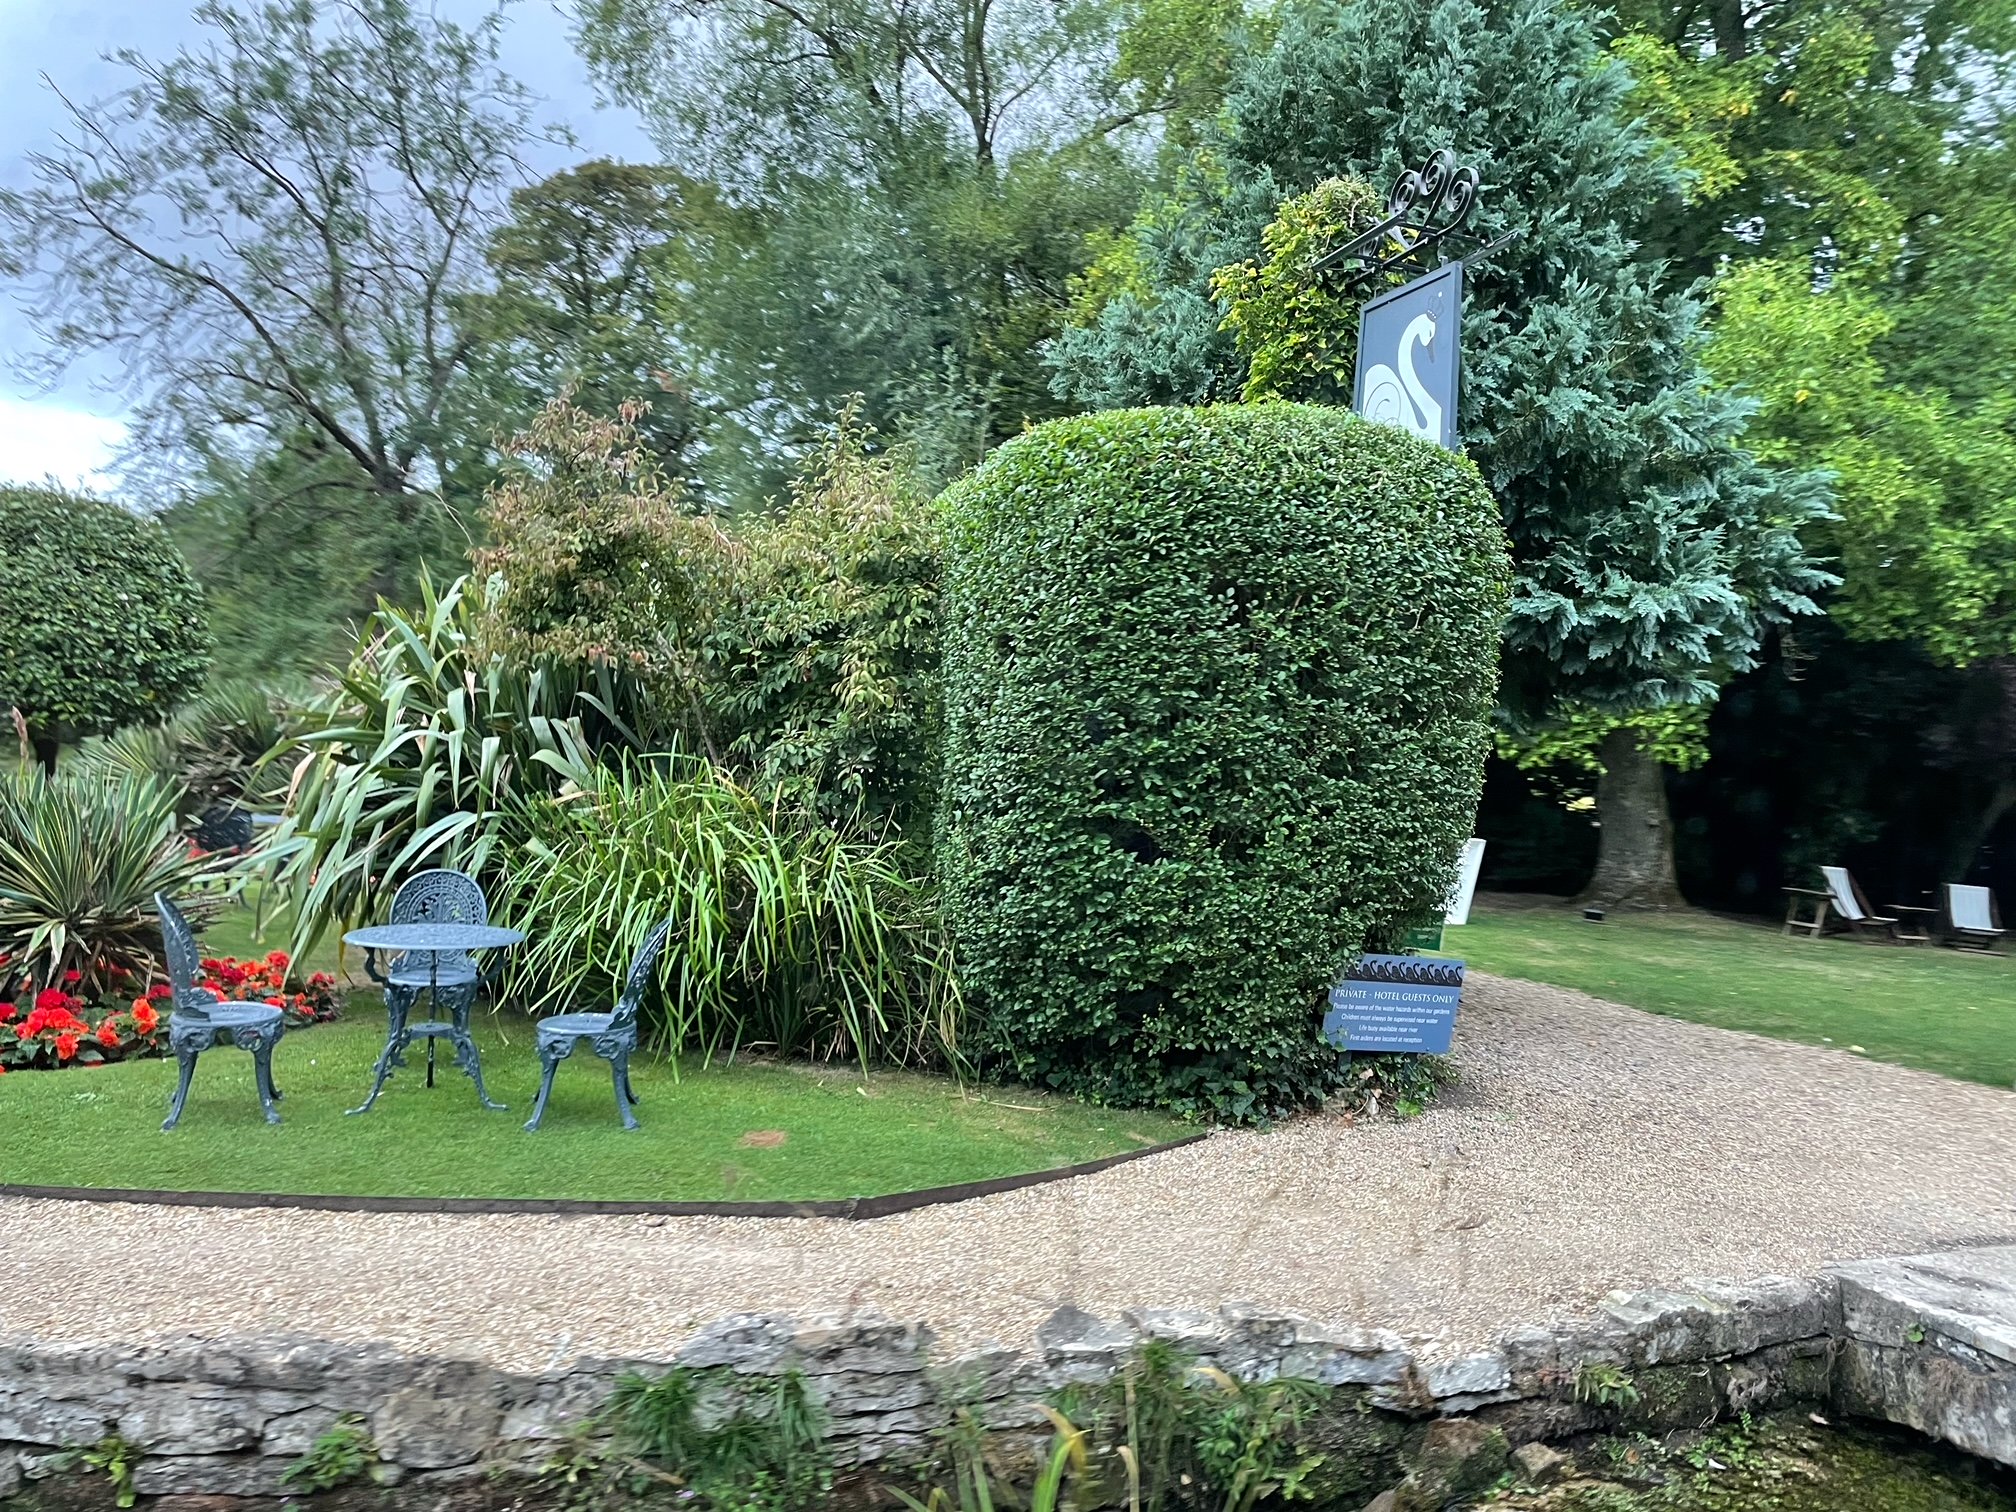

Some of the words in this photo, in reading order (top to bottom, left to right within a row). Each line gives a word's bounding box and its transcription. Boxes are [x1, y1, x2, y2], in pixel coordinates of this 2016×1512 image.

[1335, 989, 1367, 998] PRIVATE
[1374, 992, 1400, 1000] HOTEL
[1402, 992, 1430, 1002] GUESTS
[1432, 994, 1454, 1003] ONLY
